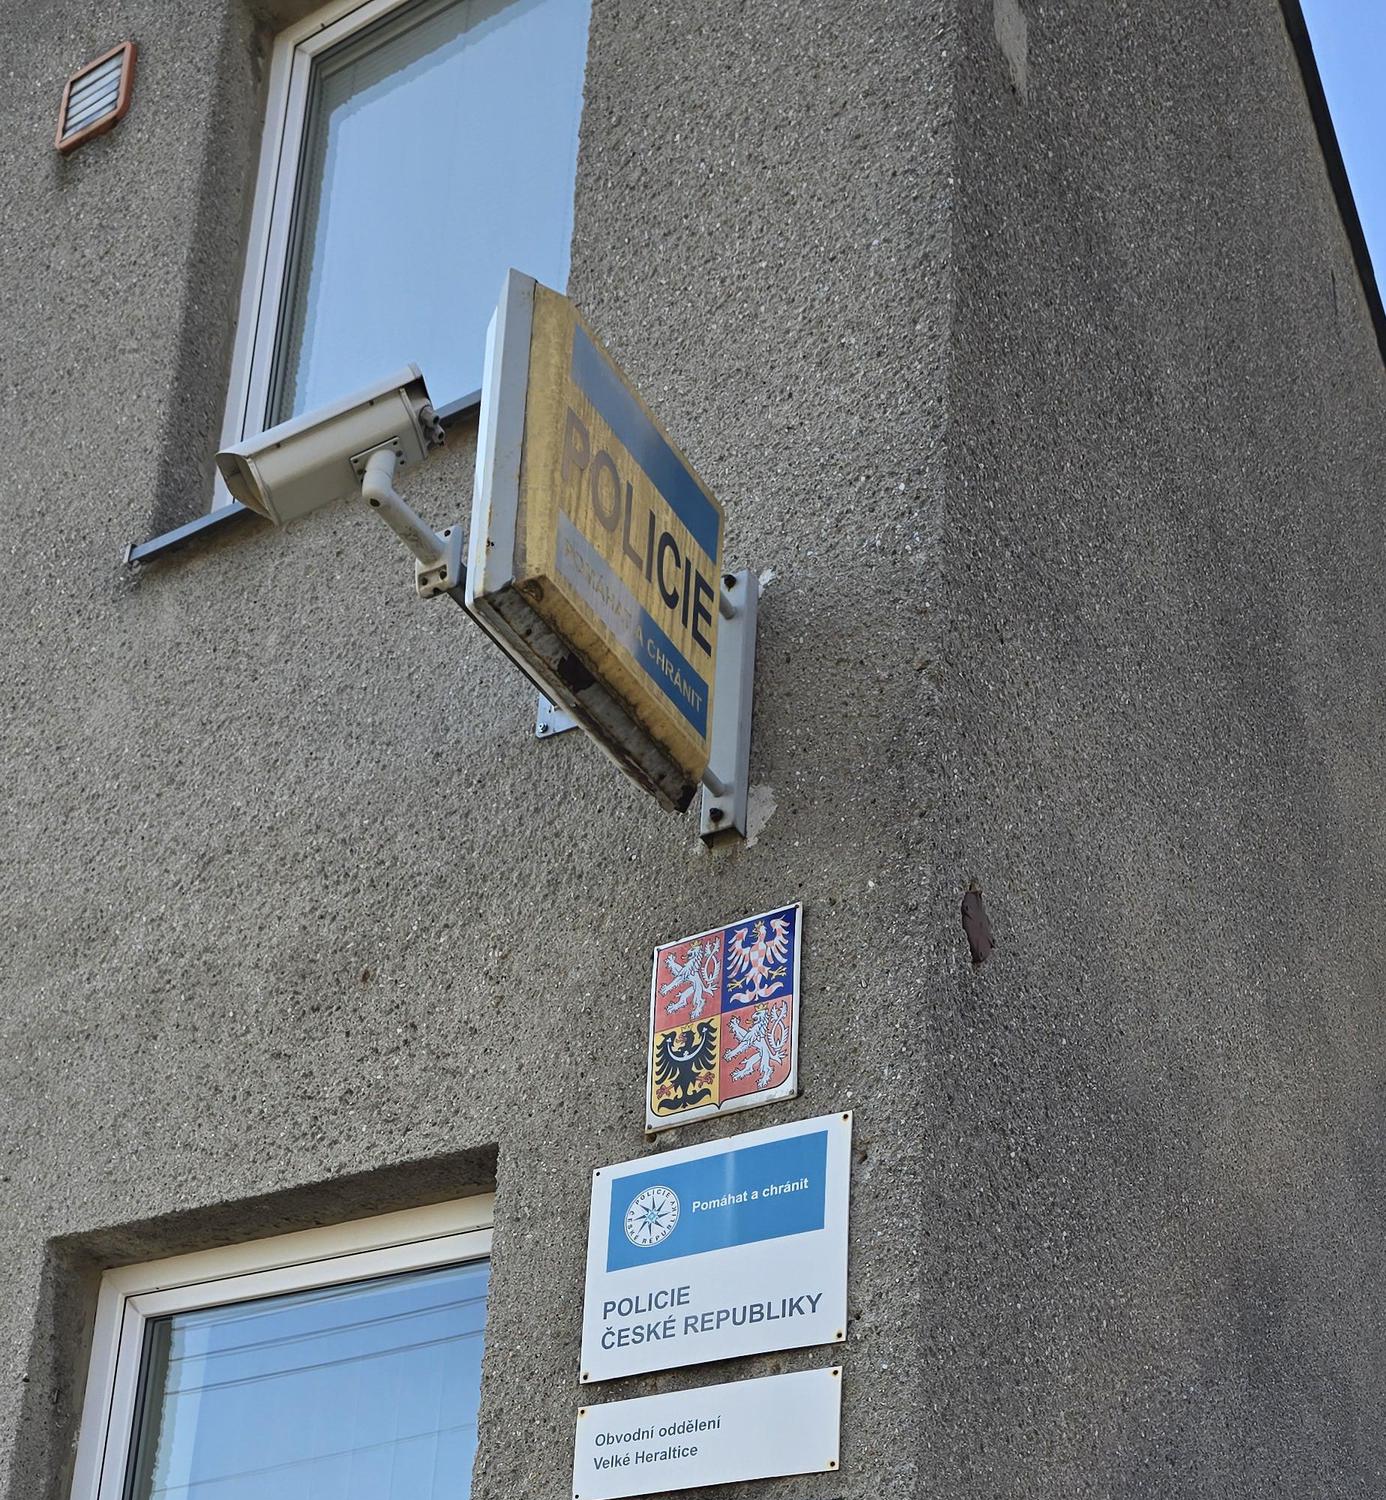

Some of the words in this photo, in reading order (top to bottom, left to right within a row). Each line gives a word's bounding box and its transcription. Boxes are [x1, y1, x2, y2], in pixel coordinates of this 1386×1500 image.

[561, 406, 715, 658] POLICIE
[635, 624, 645, 647] A
[648, 638, 703, 713] CHRÁNIT
[635, 1189, 671, 1205] POLICIE
[692, 1190, 748, 1213] Pomáhat
[751, 1190, 759, 1200] a
[762, 1177, 809, 1197] chránit
[603, 1285, 691, 1320] POLICIE
[601, 1315, 676, 1350] ČESKÉ
[683, 1292, 823, 1335] REPUBLIKY
[595, 1425, 655, 1446] Obvodní
[658, 1415, 721, 1437] oddělení
[593, 1452, 631, 1470] Velké
[635, 1445, 698, 1464] Heraltice
